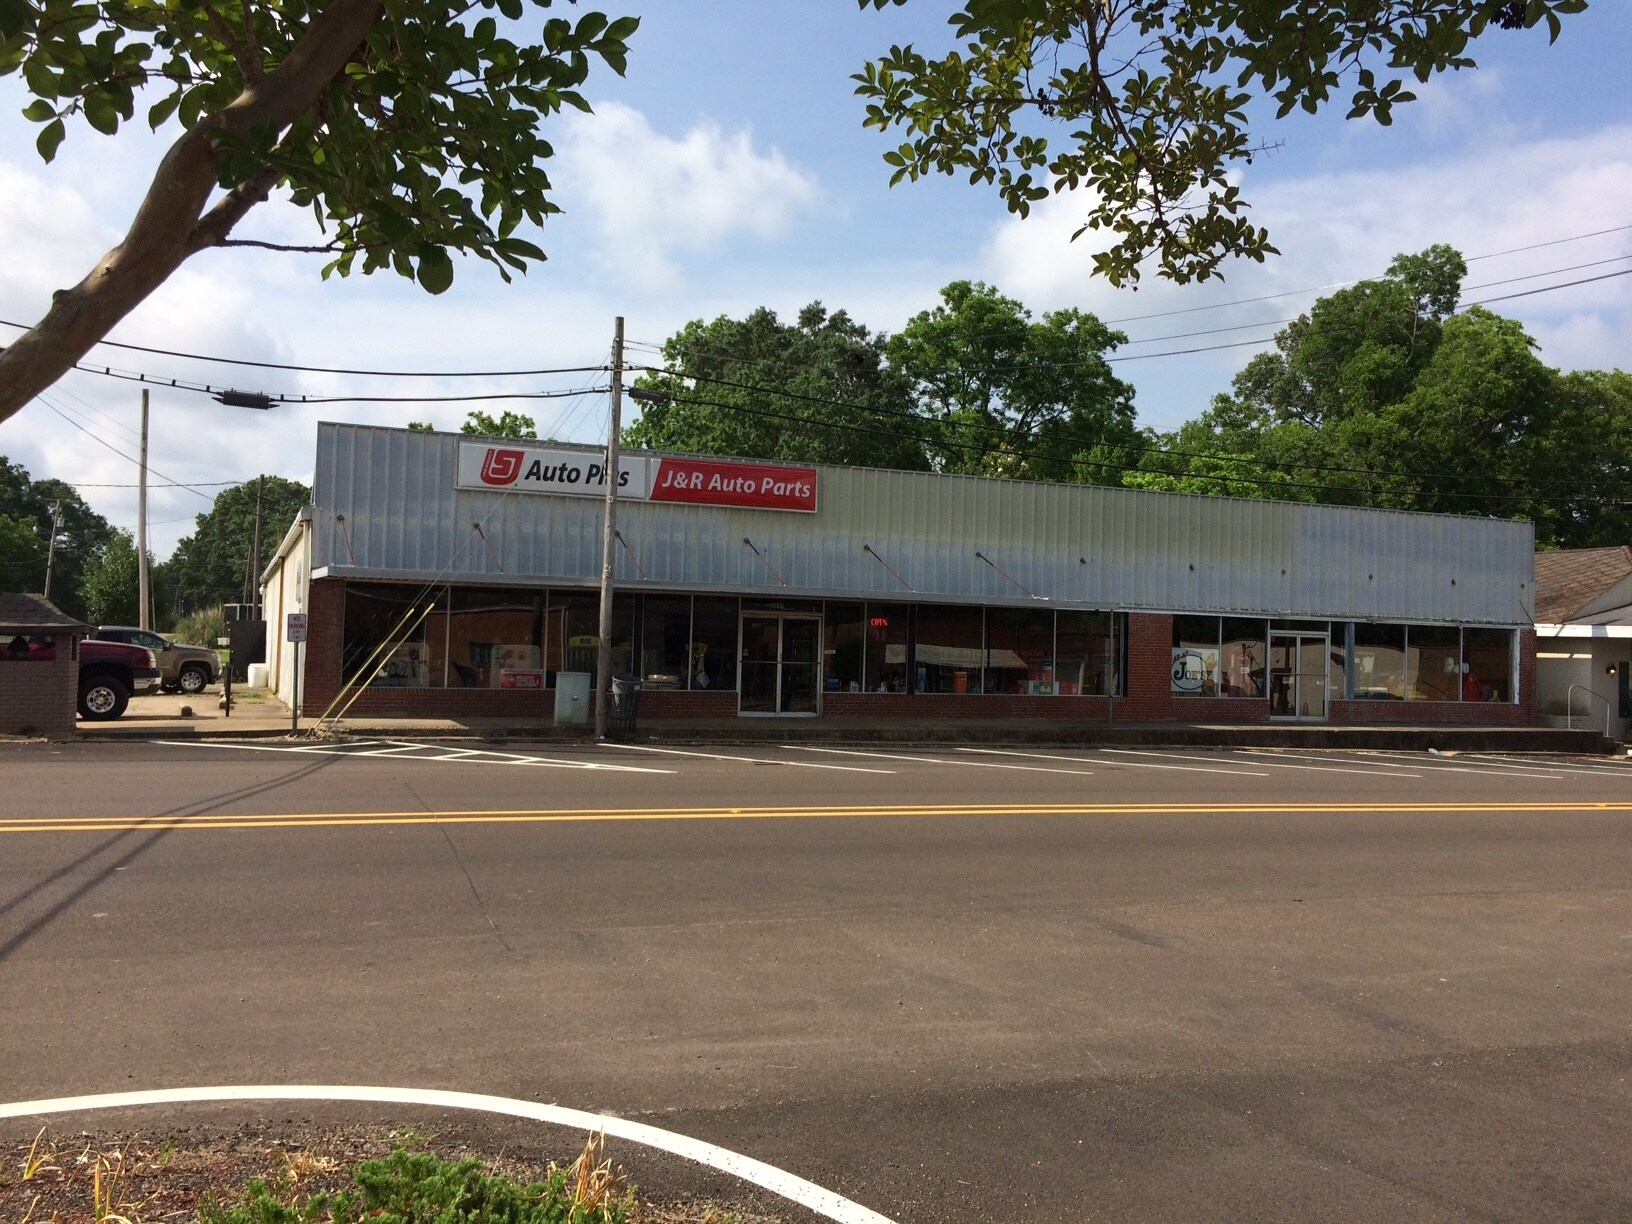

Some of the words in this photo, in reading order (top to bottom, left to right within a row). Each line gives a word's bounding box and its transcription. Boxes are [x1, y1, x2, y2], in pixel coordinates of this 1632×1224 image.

[524, 460, 581, 483] Auto
[584, 462, 630, 487] Pls
[662, 470, 704, 490] J&R
[707, 473, 756, 493] Auto
[760, 477, 811, 497] Parts
[870, 618, 888, 626] OPEN
